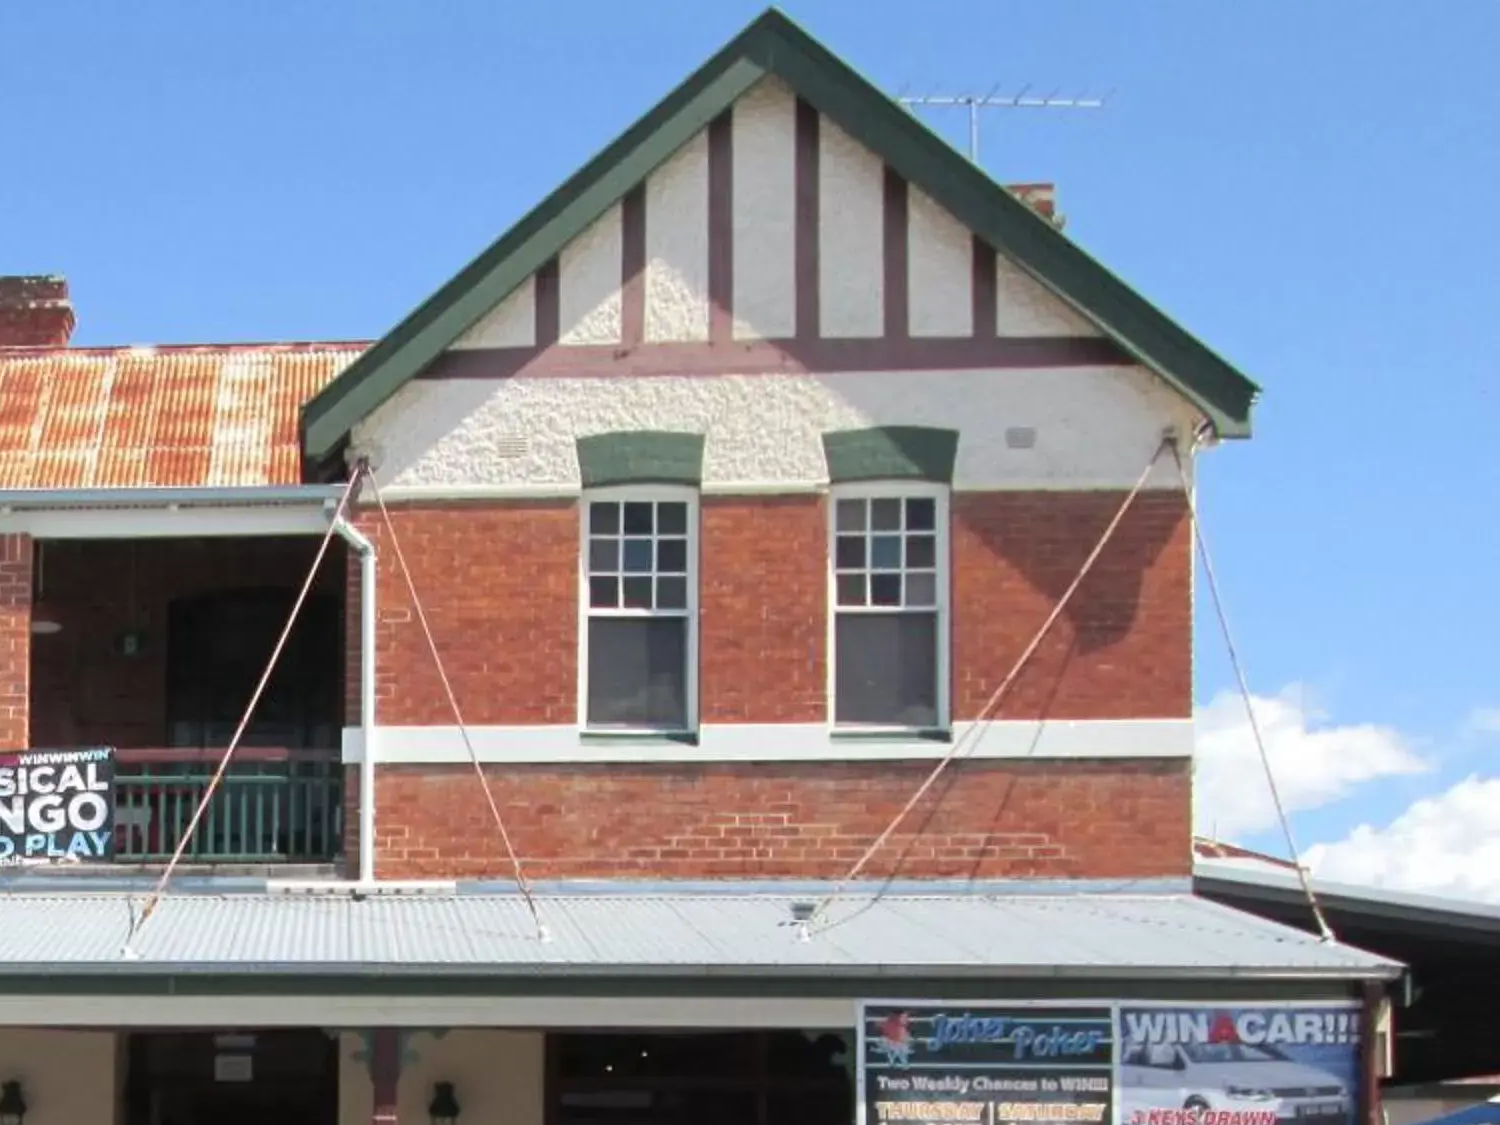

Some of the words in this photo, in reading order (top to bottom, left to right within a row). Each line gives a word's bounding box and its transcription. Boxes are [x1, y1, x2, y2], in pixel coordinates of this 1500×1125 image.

[25, 829, 112, 857] PLAY
[1126, 1012, 1208, 1043] WIN
[1209, 1017, 1240, 1044] A
[1238, 1013, 1360, 1044] CAR!!!
[1011, 1025, 1104, 1060] Poker
[877, 1075, 910, 1091] Two
[911, 1076, 969, 1094] Weekly
[972, 1077, 1038, 1092] Chances
[1041, 1077, 1058, 1092] to
[875, 1101, 985, 1121] THURSDAY
[998, 1102, 1107, 1122] SATURDAY
